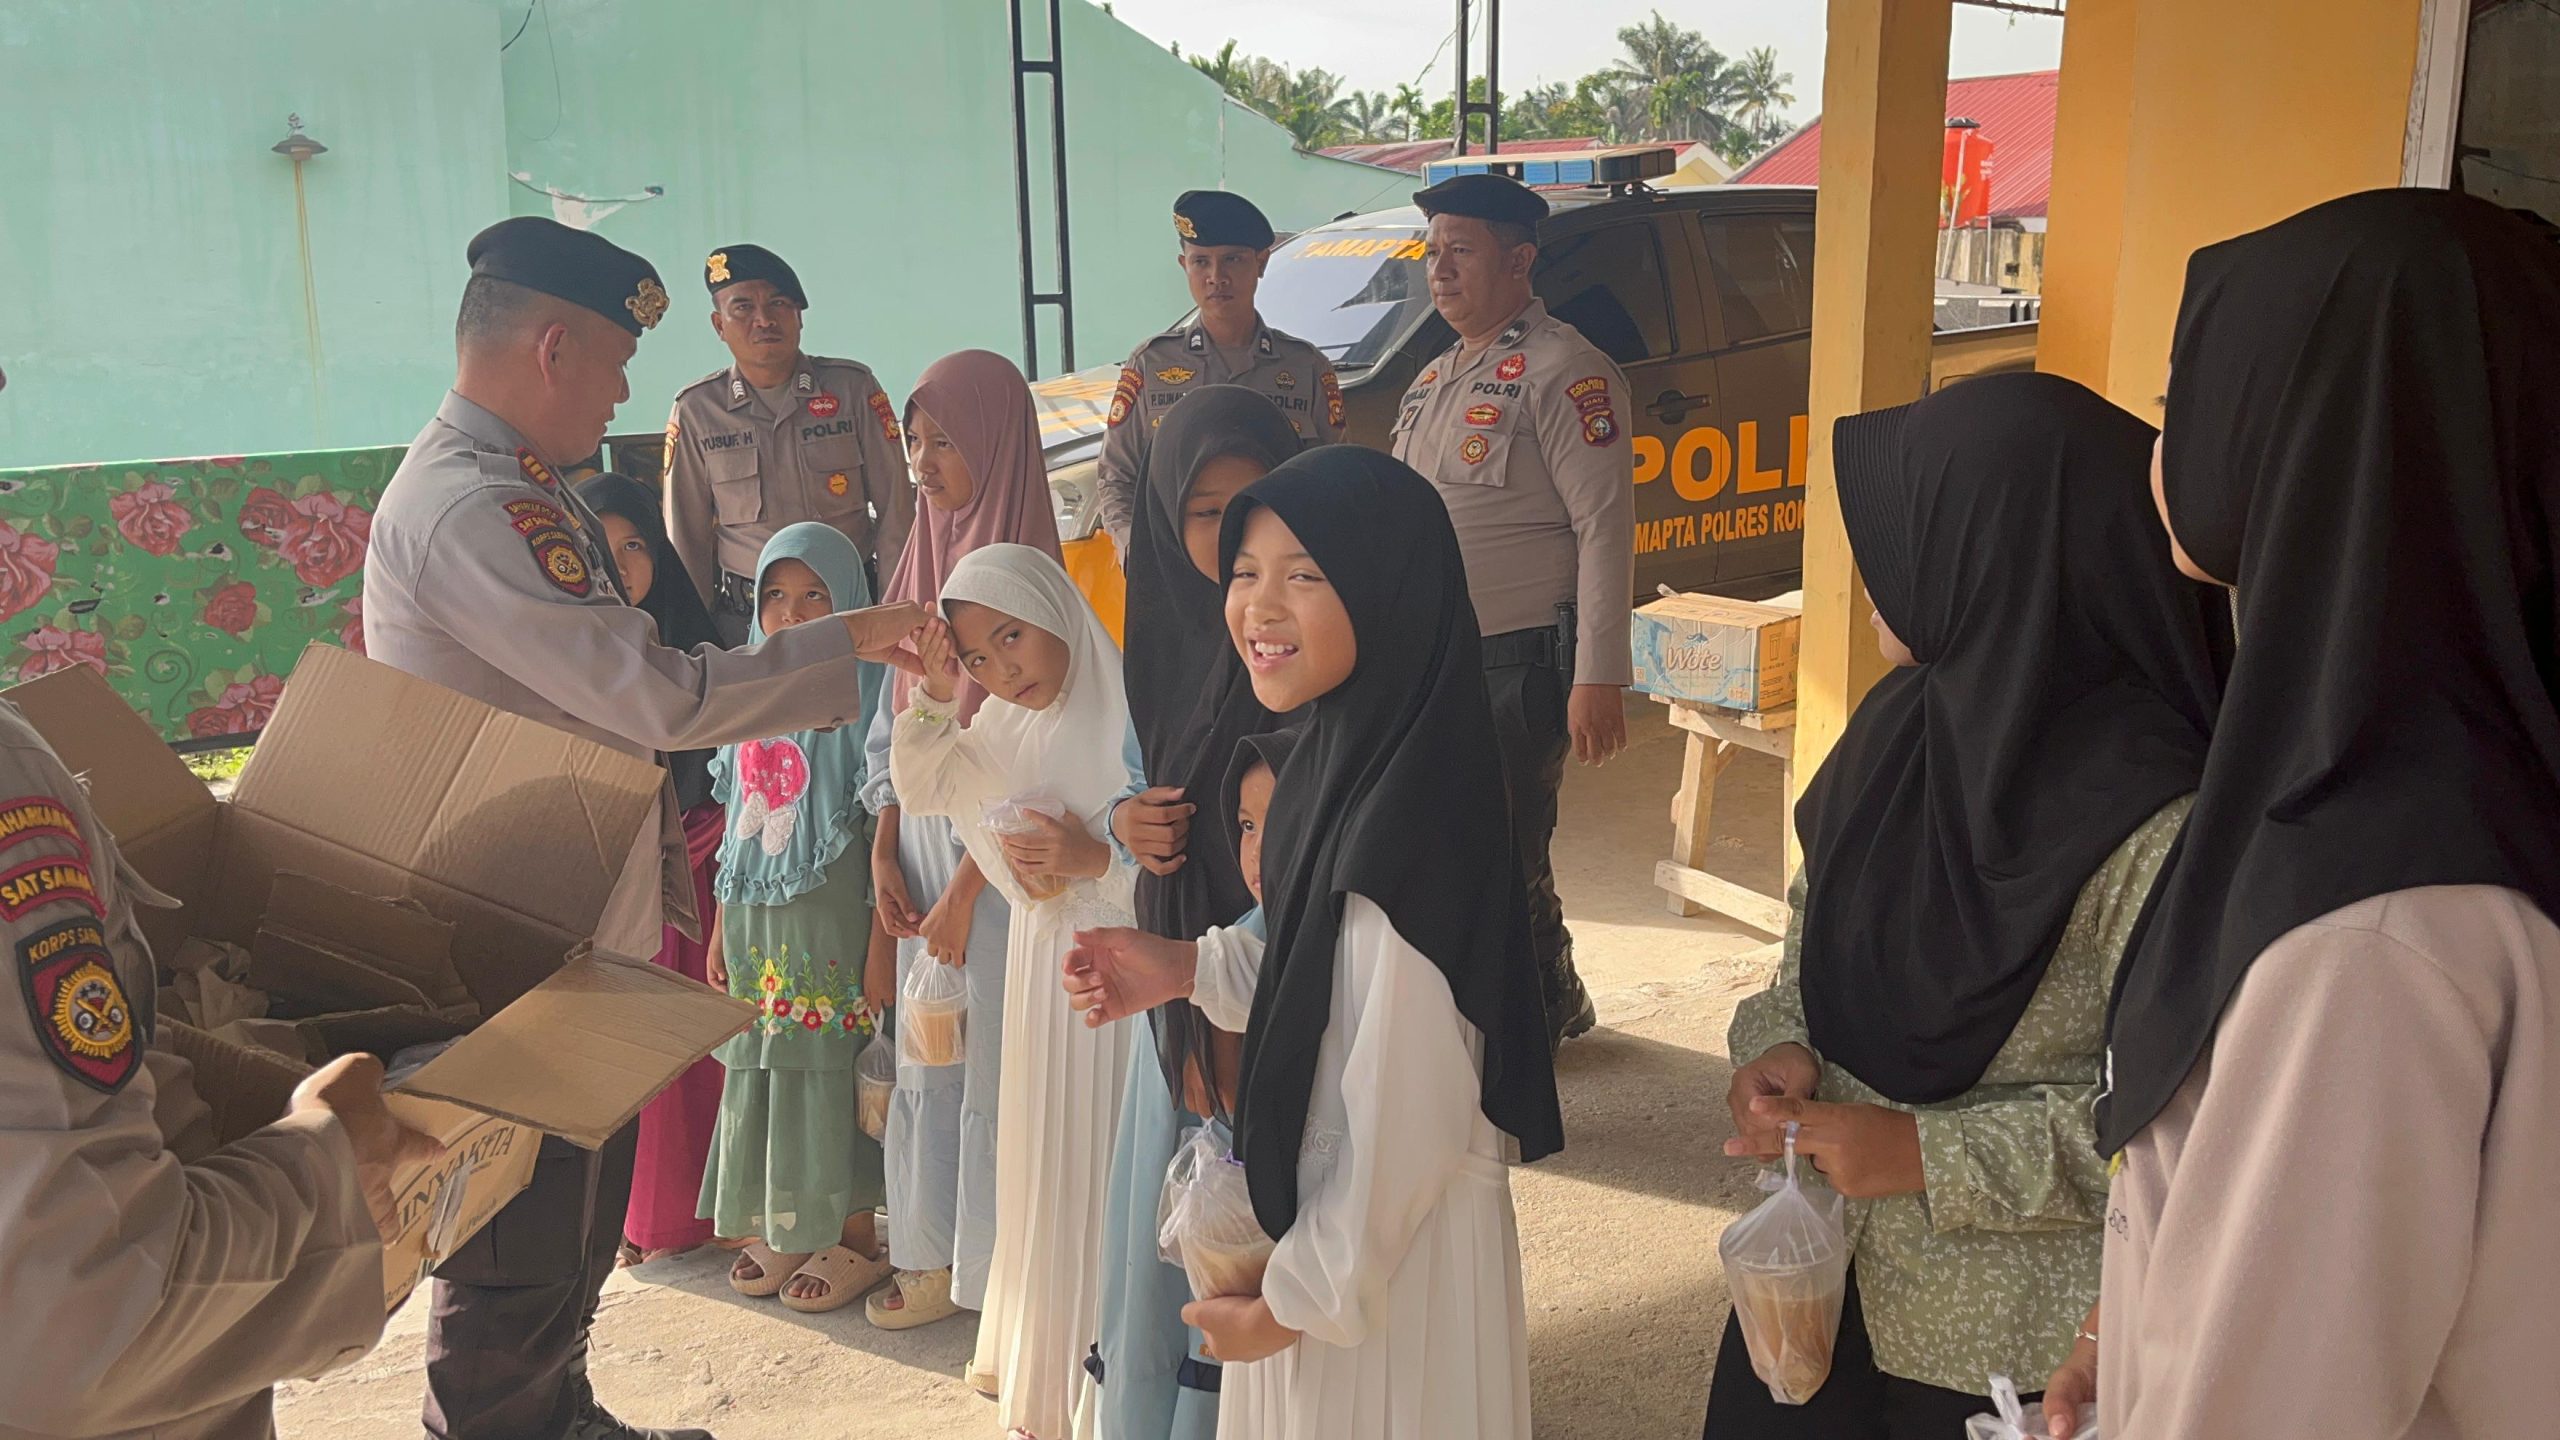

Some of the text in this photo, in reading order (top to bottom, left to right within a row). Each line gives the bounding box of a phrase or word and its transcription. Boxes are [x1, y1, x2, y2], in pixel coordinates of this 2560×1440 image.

[1471, 382, 1521, 399] POLRI
[743, 431, 754, 445] H
[801, 420, 853, 440] POLRI
[1632, 515, 1697, 555] MAPTA
[1701, 504, 1768, 545] POLRES
[1, 873, 41, 906] SAT
[28, 929, 76, 964] KORPS
